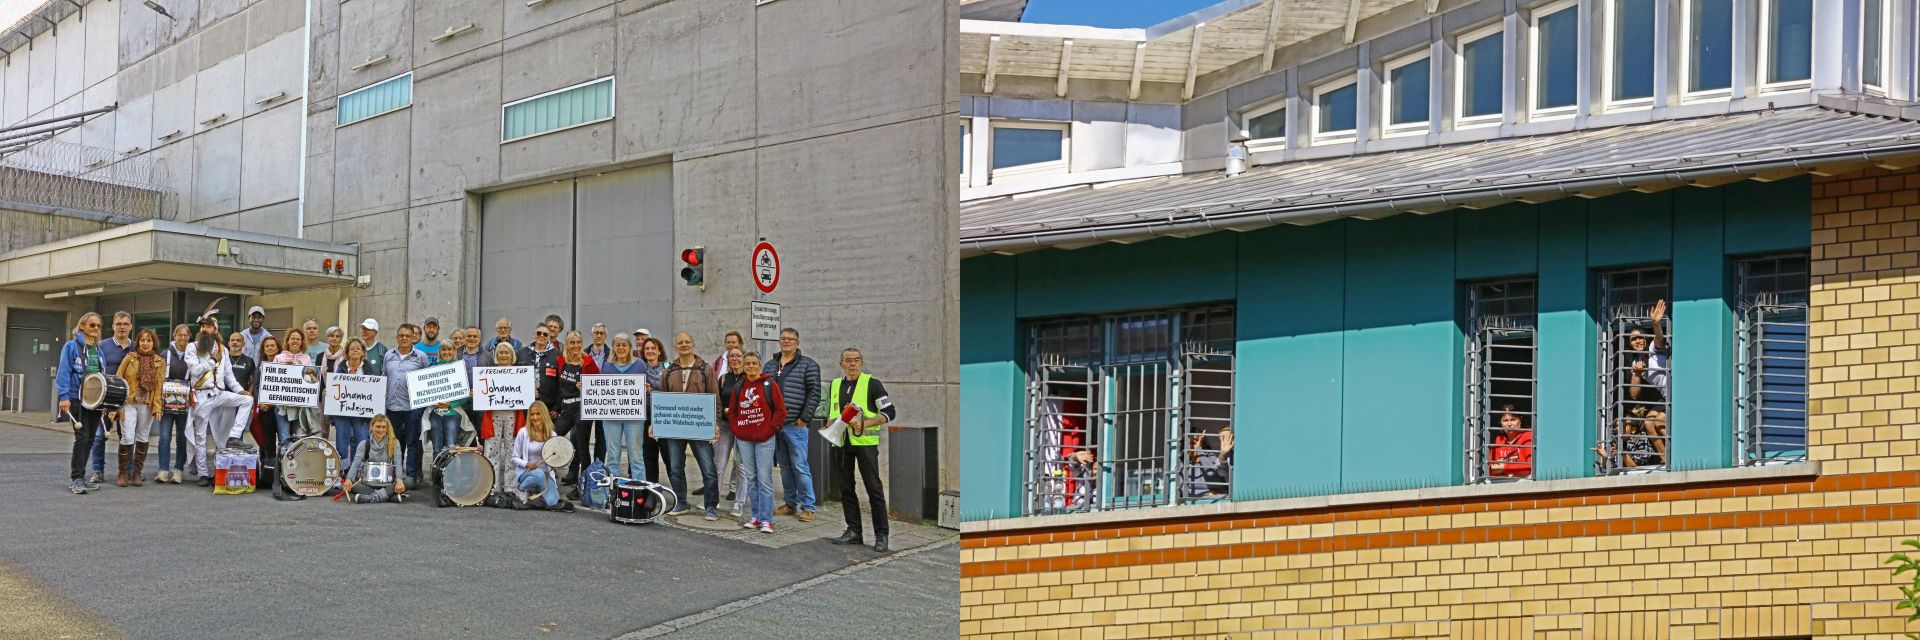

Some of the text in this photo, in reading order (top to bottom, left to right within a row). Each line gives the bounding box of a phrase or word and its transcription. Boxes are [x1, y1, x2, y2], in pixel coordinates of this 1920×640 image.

[264, 376, 302, 384] FREILASSUNG
[428, 378, 448, 387] MEDIEN
[480, 378, 522, 395] Johanna
[282, 386, 317, 394] POLITISCHEN
[332, 384, 372, 401] Johanna
[416, 384, 452, 397] INZWISCHEN
[268, 394, 306, 402] GEFANGENEN
[413, 388, 468, 406] RECHTSPRECHUNG?
[488, 394, 524, 408] Findeisen
[340, 400, 374, 415] Findeisen
